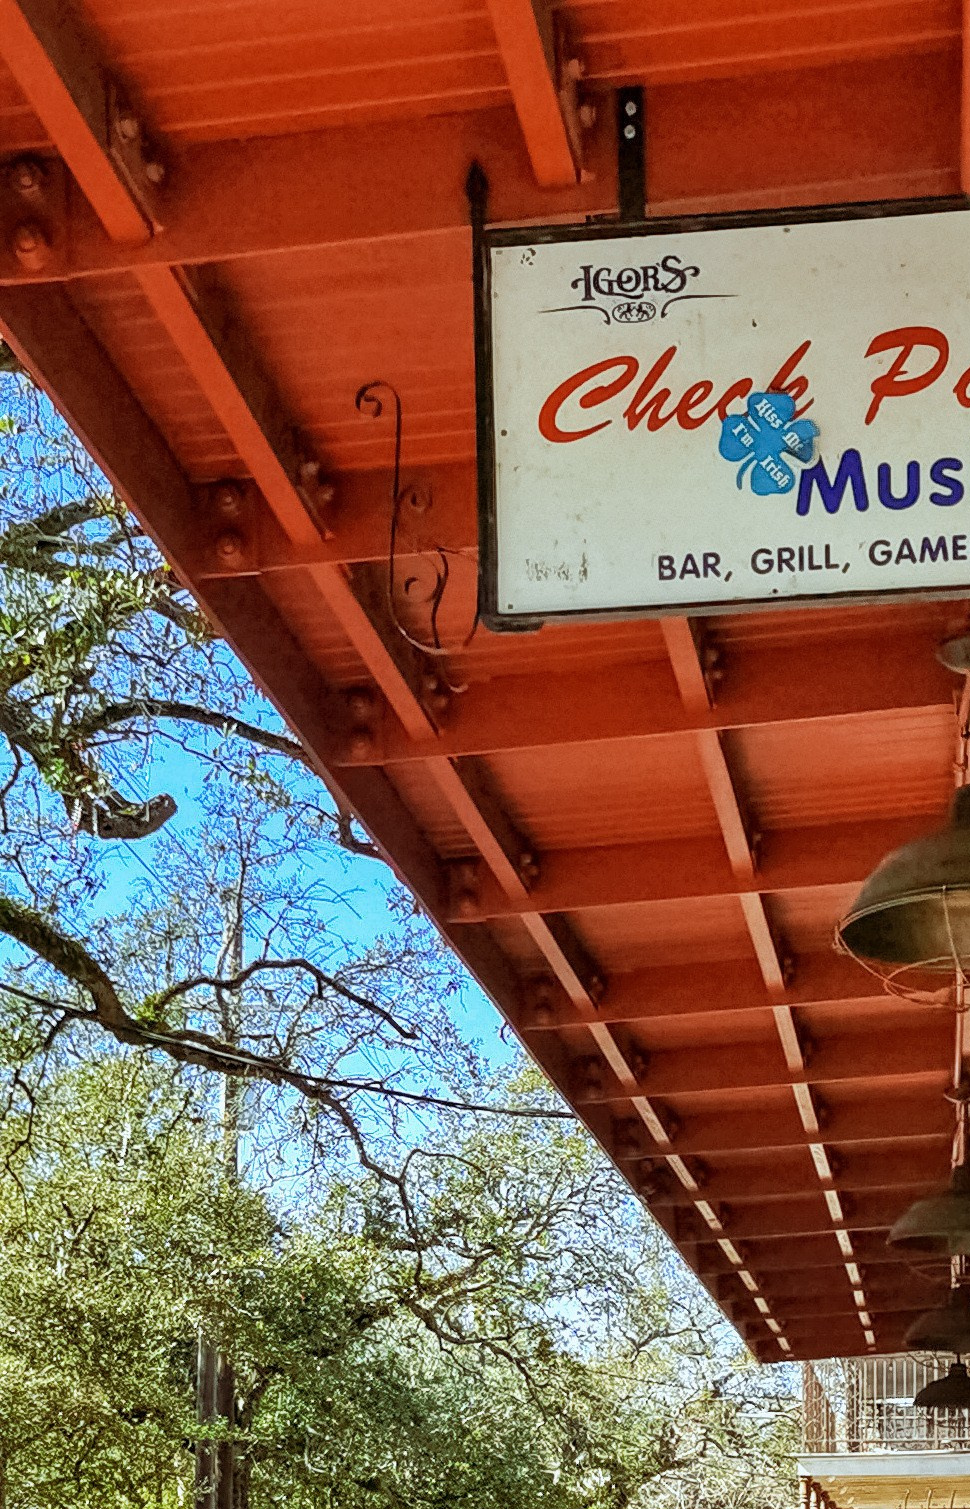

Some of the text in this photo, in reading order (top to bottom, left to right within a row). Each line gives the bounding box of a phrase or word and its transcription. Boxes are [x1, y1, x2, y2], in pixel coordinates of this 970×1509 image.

[754, 399, 783, 429] Kiss
[732, 422, 790, 488] I'm Irish
[657, 552, 732, 583] BAR,
[750, 544, 851, 575] GRILL,
